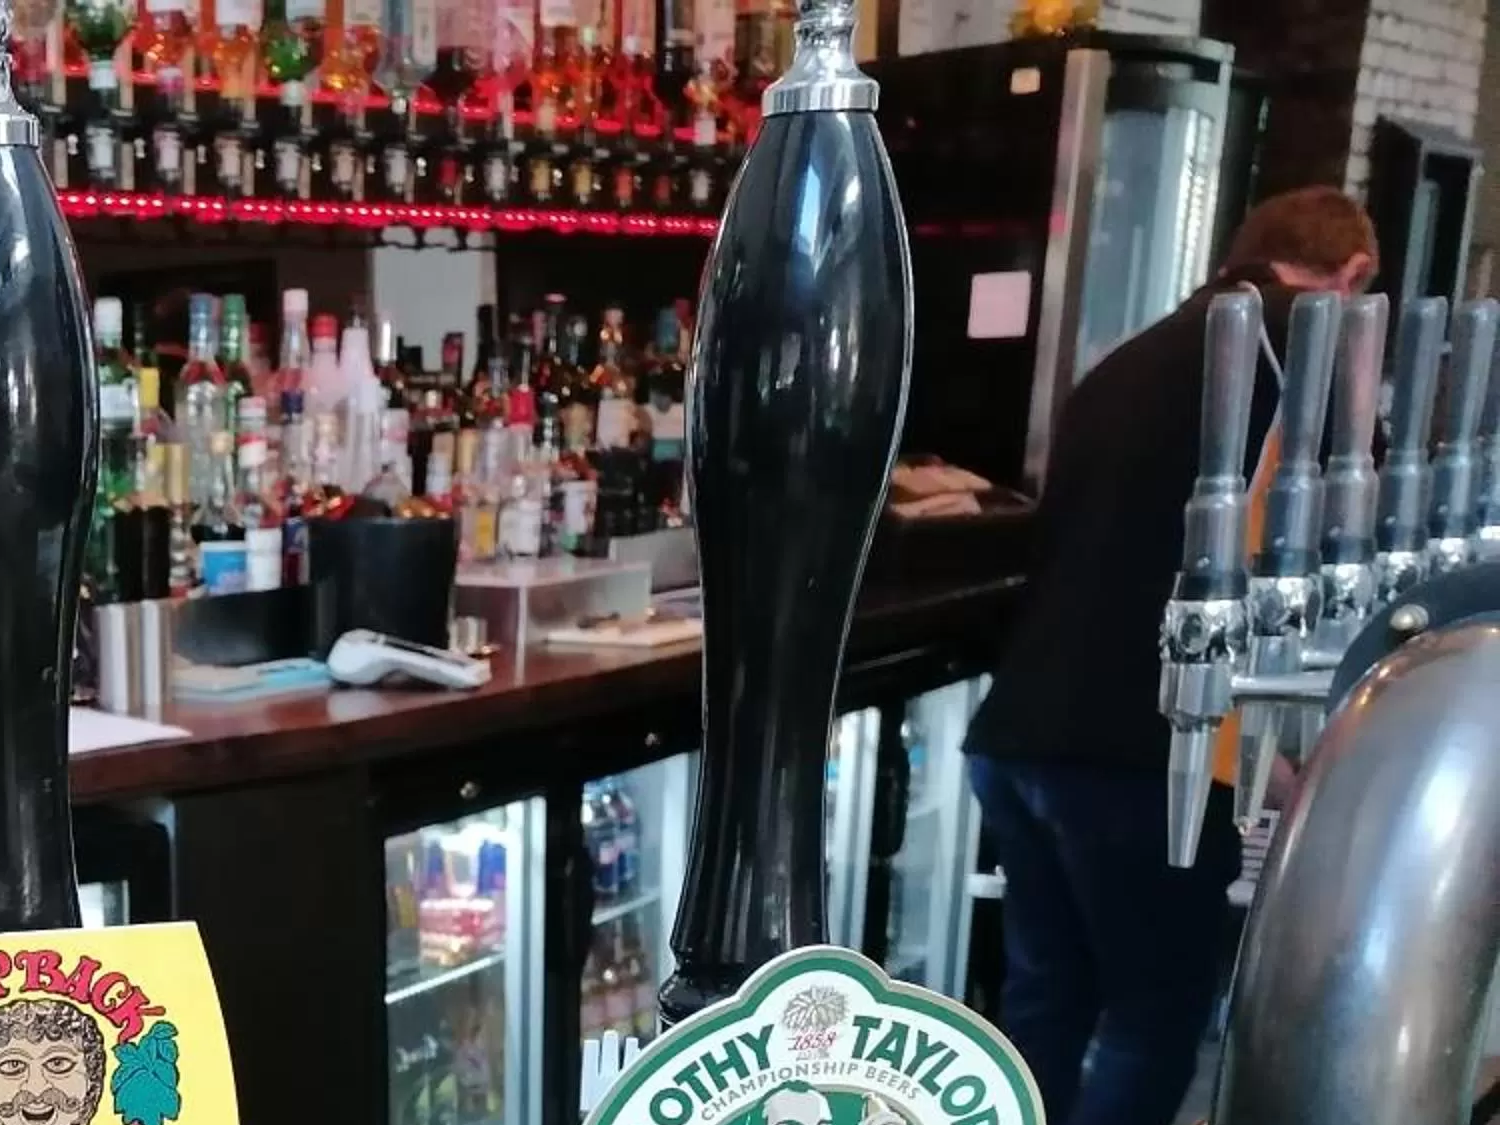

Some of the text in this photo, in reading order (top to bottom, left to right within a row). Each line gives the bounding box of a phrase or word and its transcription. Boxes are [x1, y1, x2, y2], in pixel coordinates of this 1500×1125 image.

[14, 950, 166, 1044] BACK
[788, 1031, 836, 1050] 1858
[701, 1060, 921, 1121] CHAMPIONSHIP BEERS
